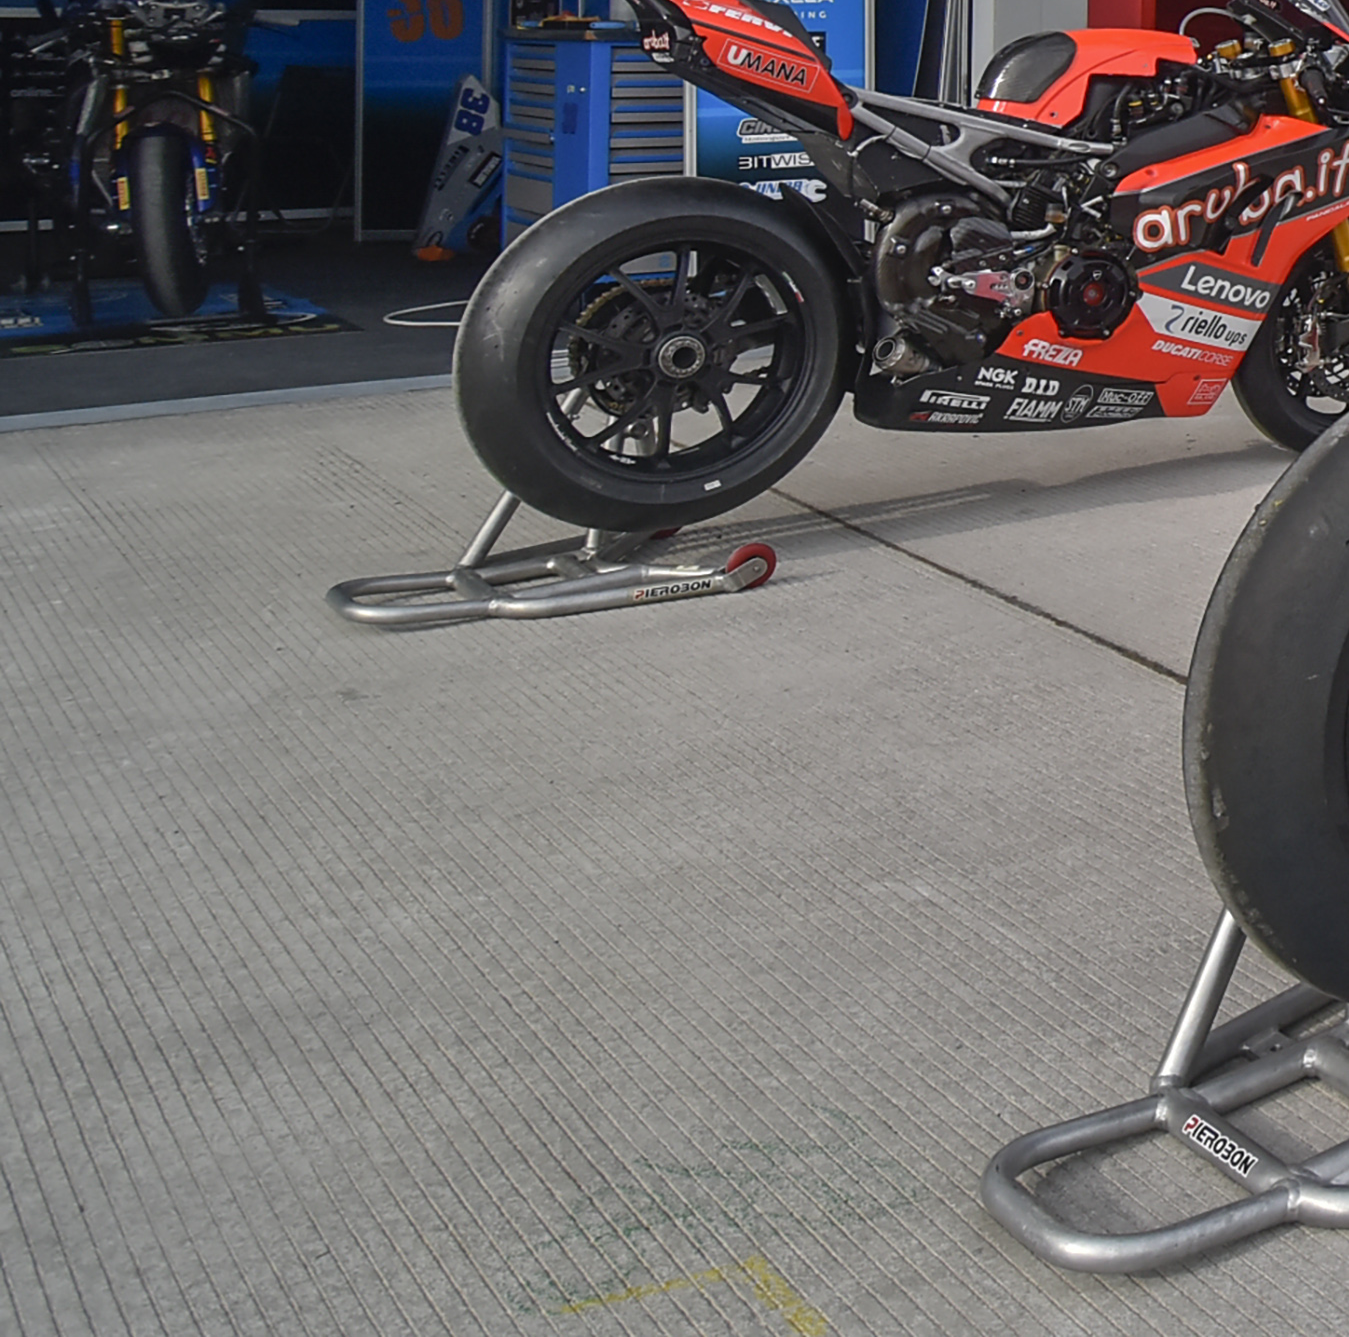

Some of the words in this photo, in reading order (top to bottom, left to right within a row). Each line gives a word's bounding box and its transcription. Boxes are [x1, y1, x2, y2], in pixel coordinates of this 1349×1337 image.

[727, 44, 808, 86] UMANA
[454, 87, 490, 137] 38
[1181, 264, 1271, 310] Lenovo
[1182, 311, 1225, 340] riello
[1225, 328, 1248, 347] ups
[977, 366, 1019, 385] NGK
[919, 389, 992, 411] PIRELLI
[1005, 397, 1064, 419] FIAMM
[633, 579, 712, 602] PIEROBON
[1181, 1113, 1258, 1177] PIEROBON
